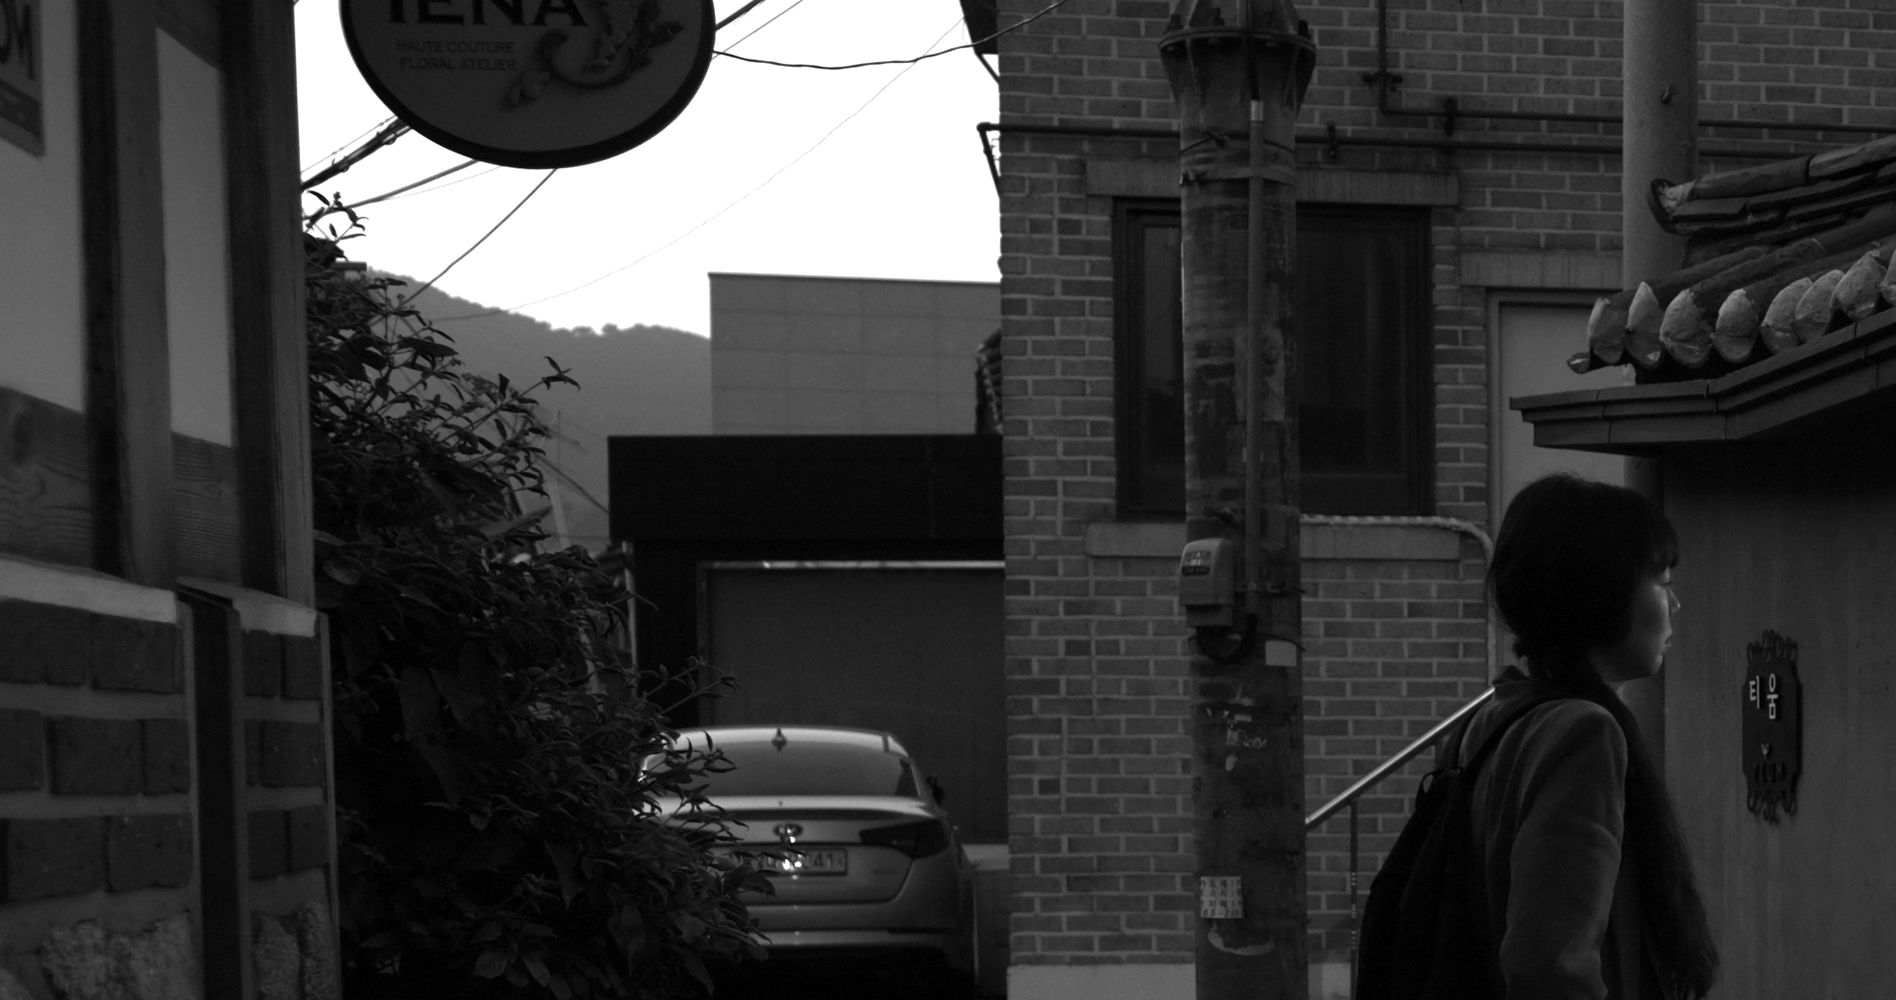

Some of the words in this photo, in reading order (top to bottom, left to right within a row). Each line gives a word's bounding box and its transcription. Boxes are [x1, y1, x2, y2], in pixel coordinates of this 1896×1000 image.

[396, 40, 443, 53] HAUTE
[446, 41, 515, 54] COUTURE
[399, 58, 456, 70] FLORAL
[461, 58, 517, 71] ATELIER
[1749, 672, 1779, 720] 티움
